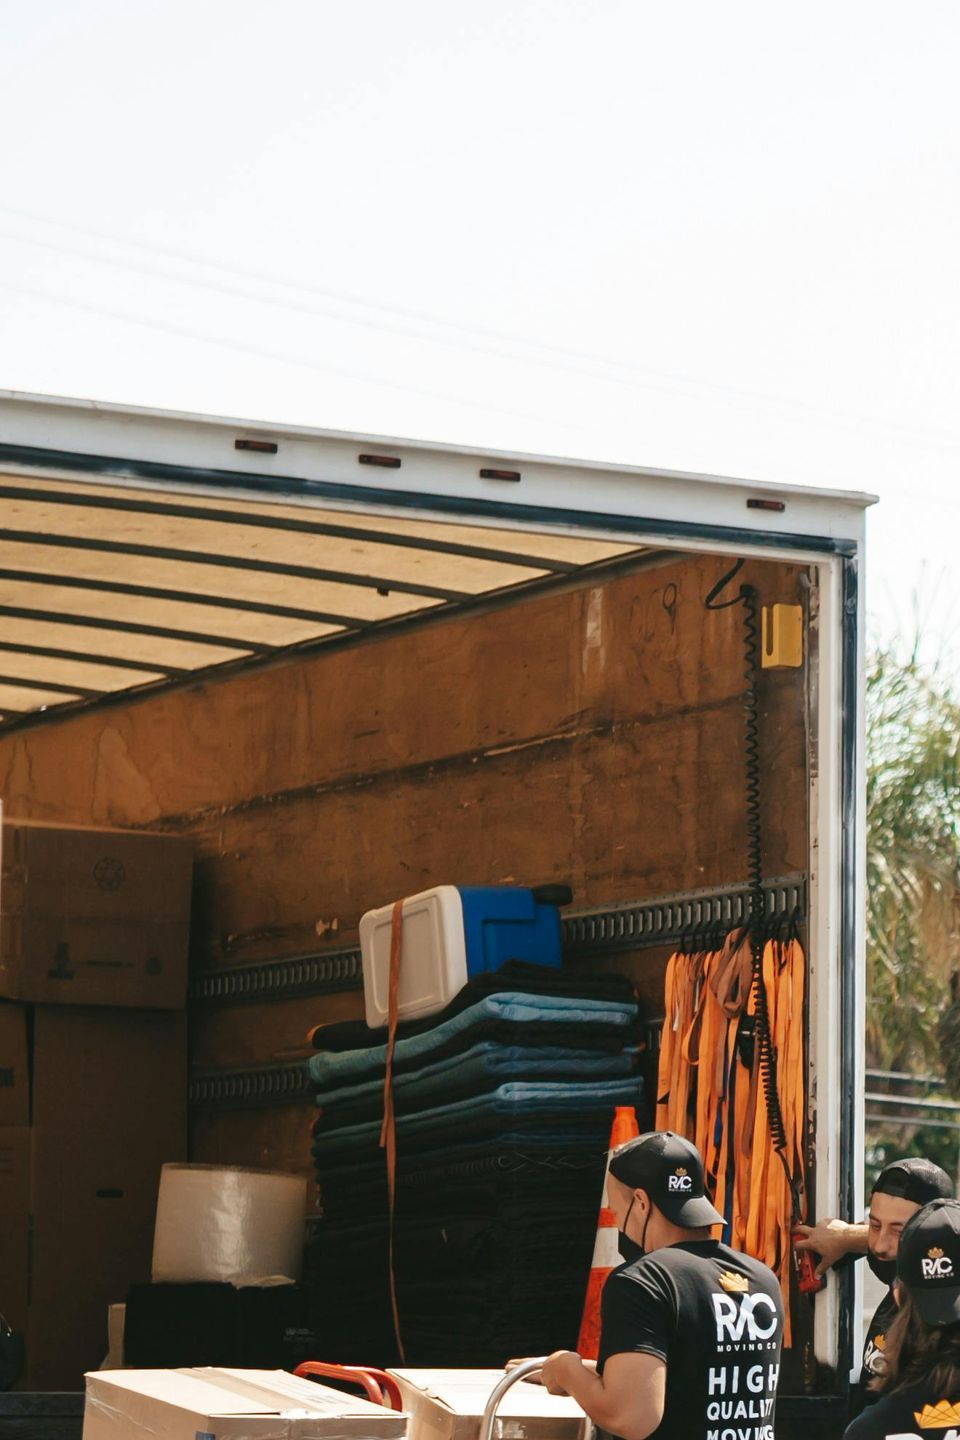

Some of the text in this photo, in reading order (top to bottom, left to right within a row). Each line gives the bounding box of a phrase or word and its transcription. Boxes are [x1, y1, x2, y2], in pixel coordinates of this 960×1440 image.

[717, 1341, 777, 1352] MOVING CO
[708, 1363, 780, 1396] HIGH
